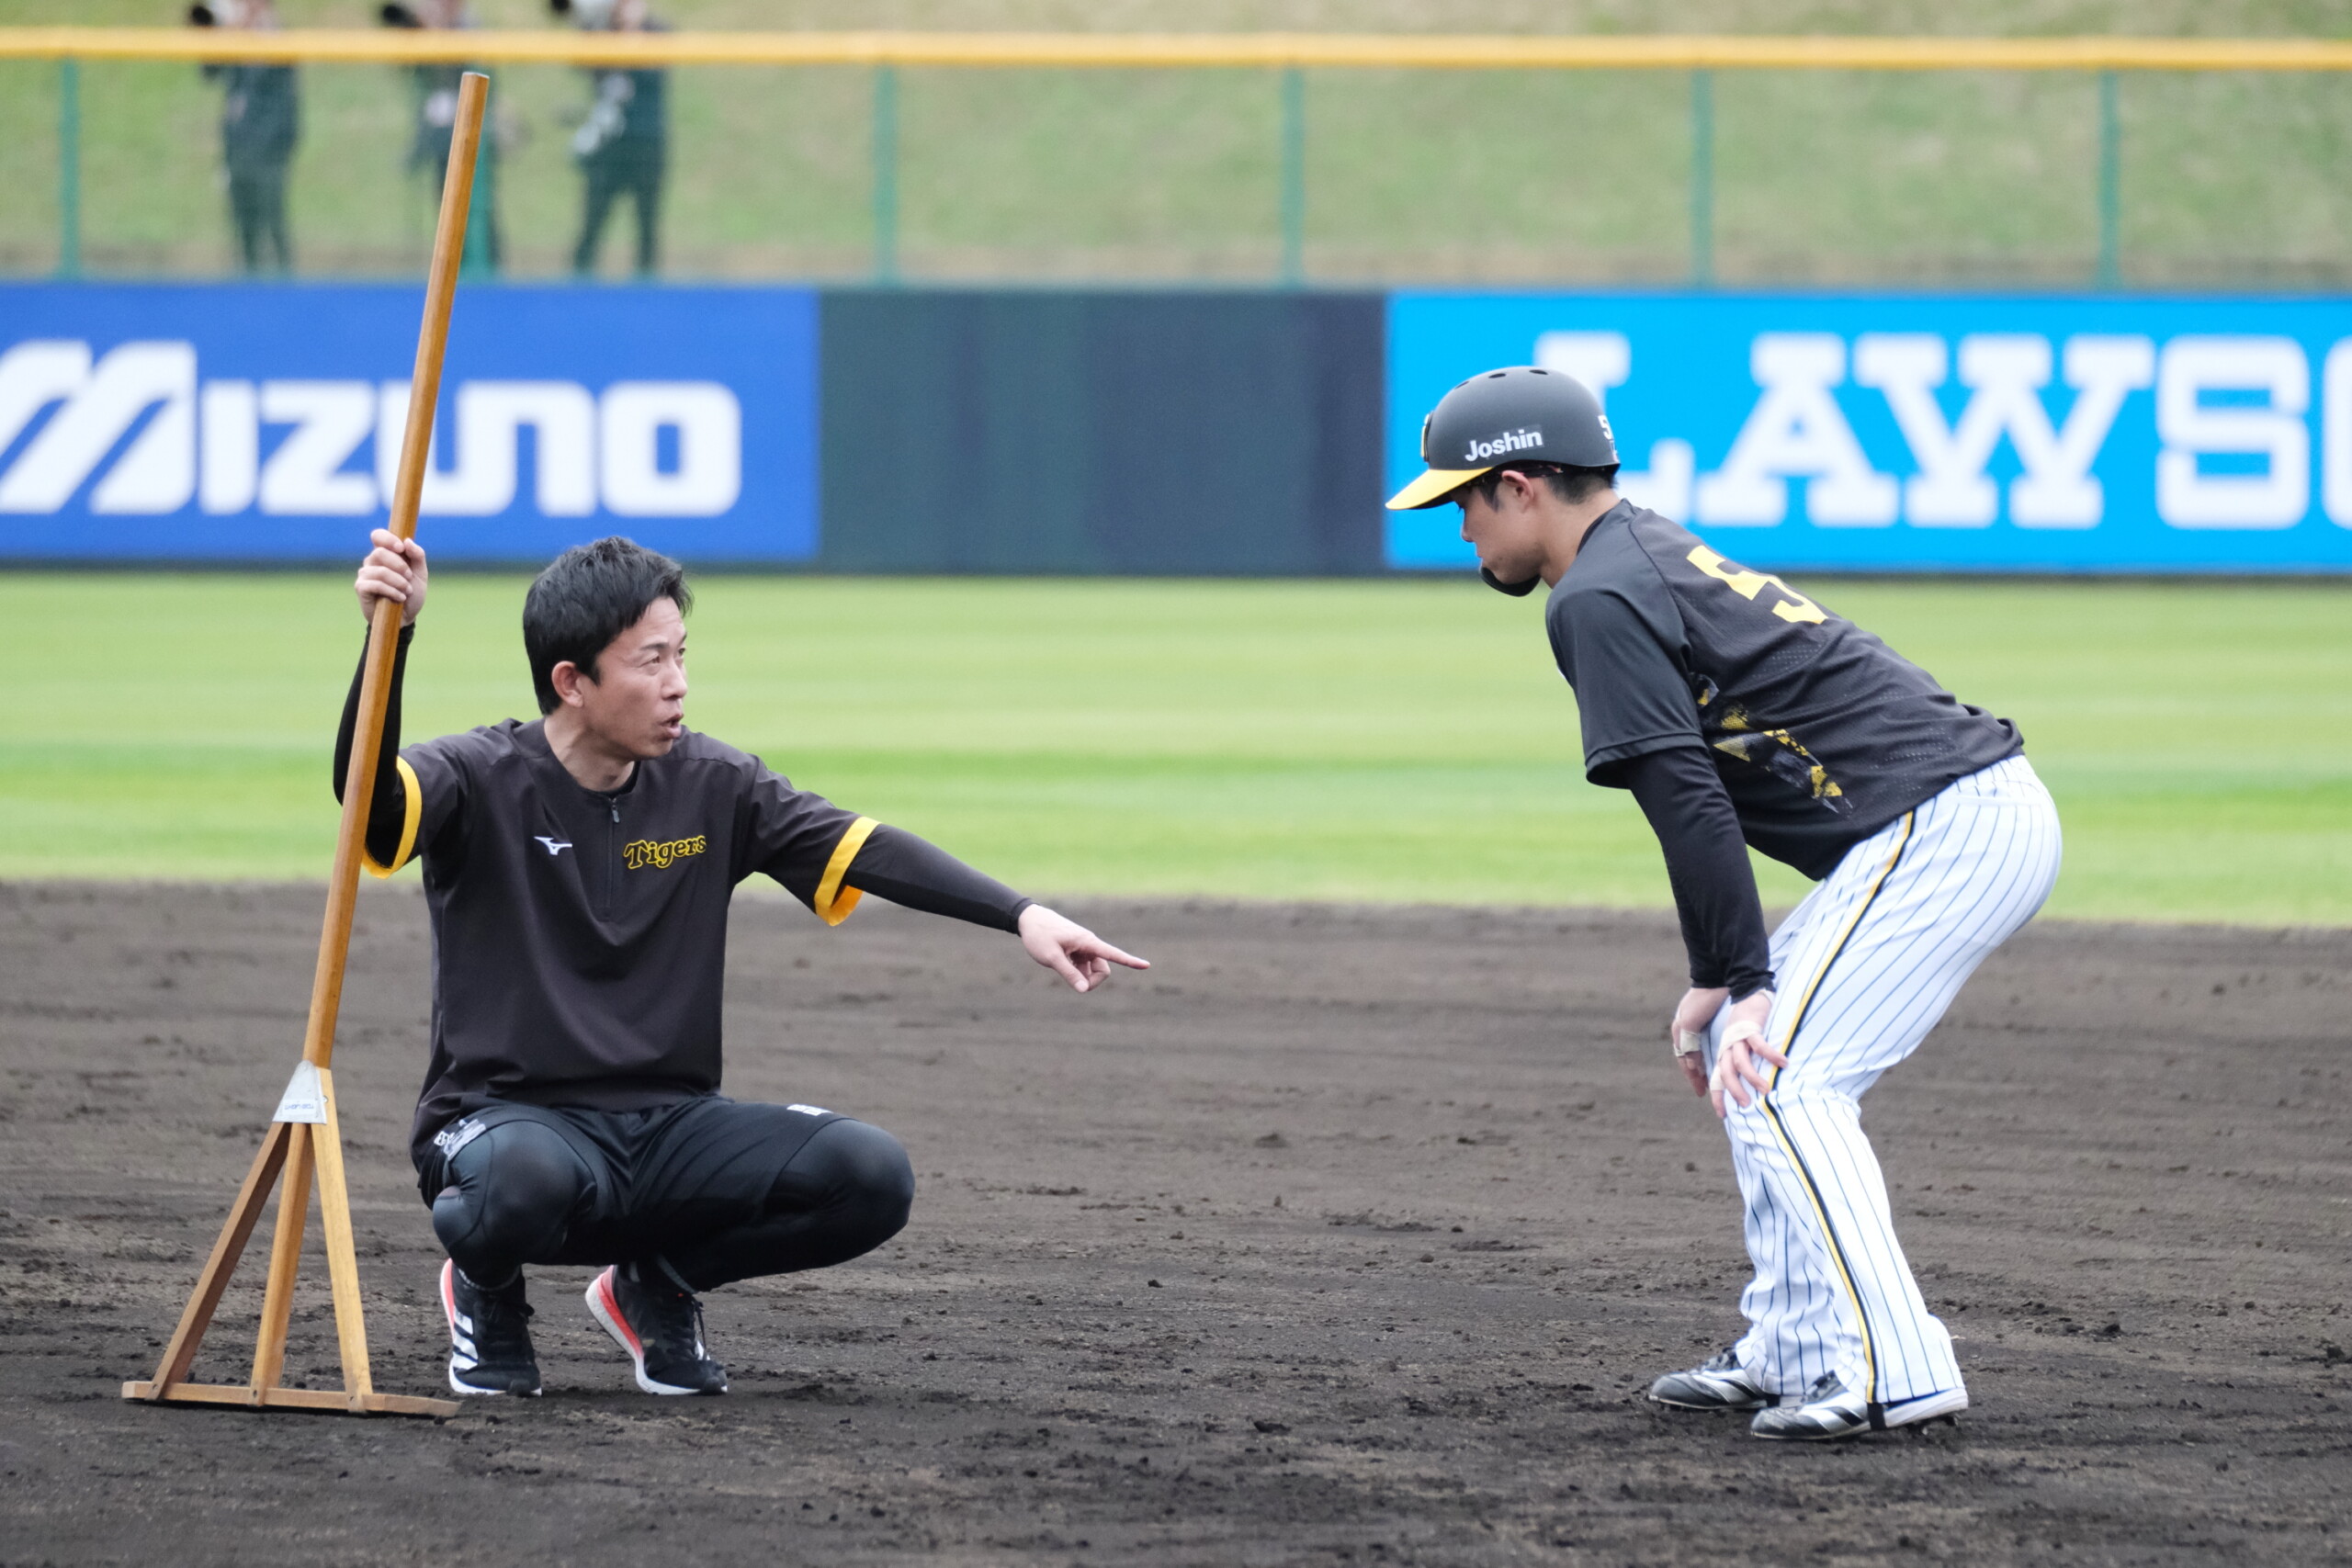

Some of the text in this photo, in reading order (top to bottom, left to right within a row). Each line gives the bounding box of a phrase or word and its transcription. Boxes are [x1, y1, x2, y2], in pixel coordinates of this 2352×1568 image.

[0, 339, 741, 516] MIZUNO
[1464, 428, 1544, 462] Joshin
[623, 834, 707, 870] Tigers
